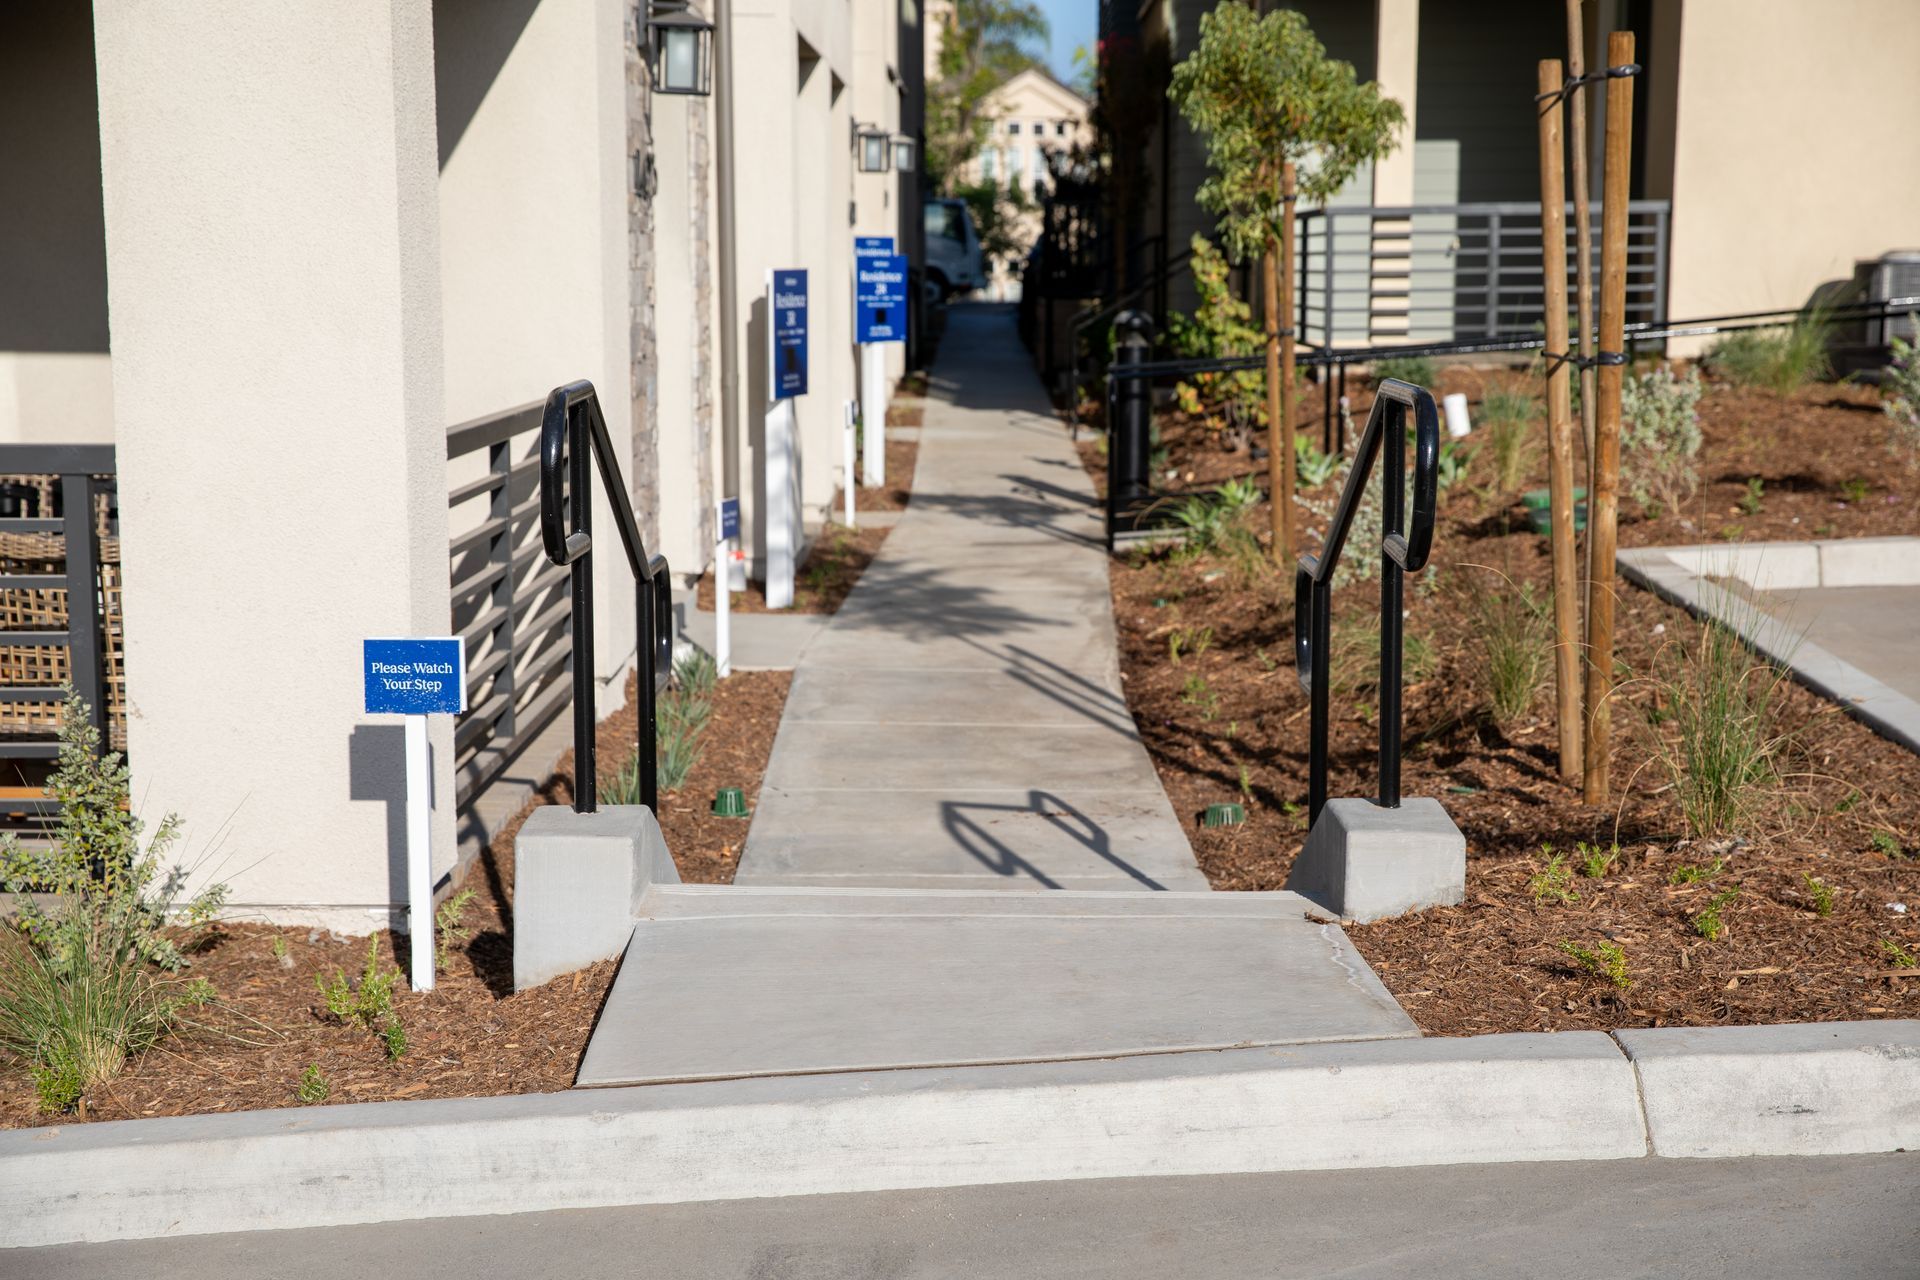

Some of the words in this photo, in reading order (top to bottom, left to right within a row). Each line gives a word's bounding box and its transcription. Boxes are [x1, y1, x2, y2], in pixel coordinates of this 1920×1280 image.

[371, 662, 411, 674] Please
[412, 662, 453, 674] Watch
[383, 678, 412, 690] Your
[414, 678, 443, 692] Step
